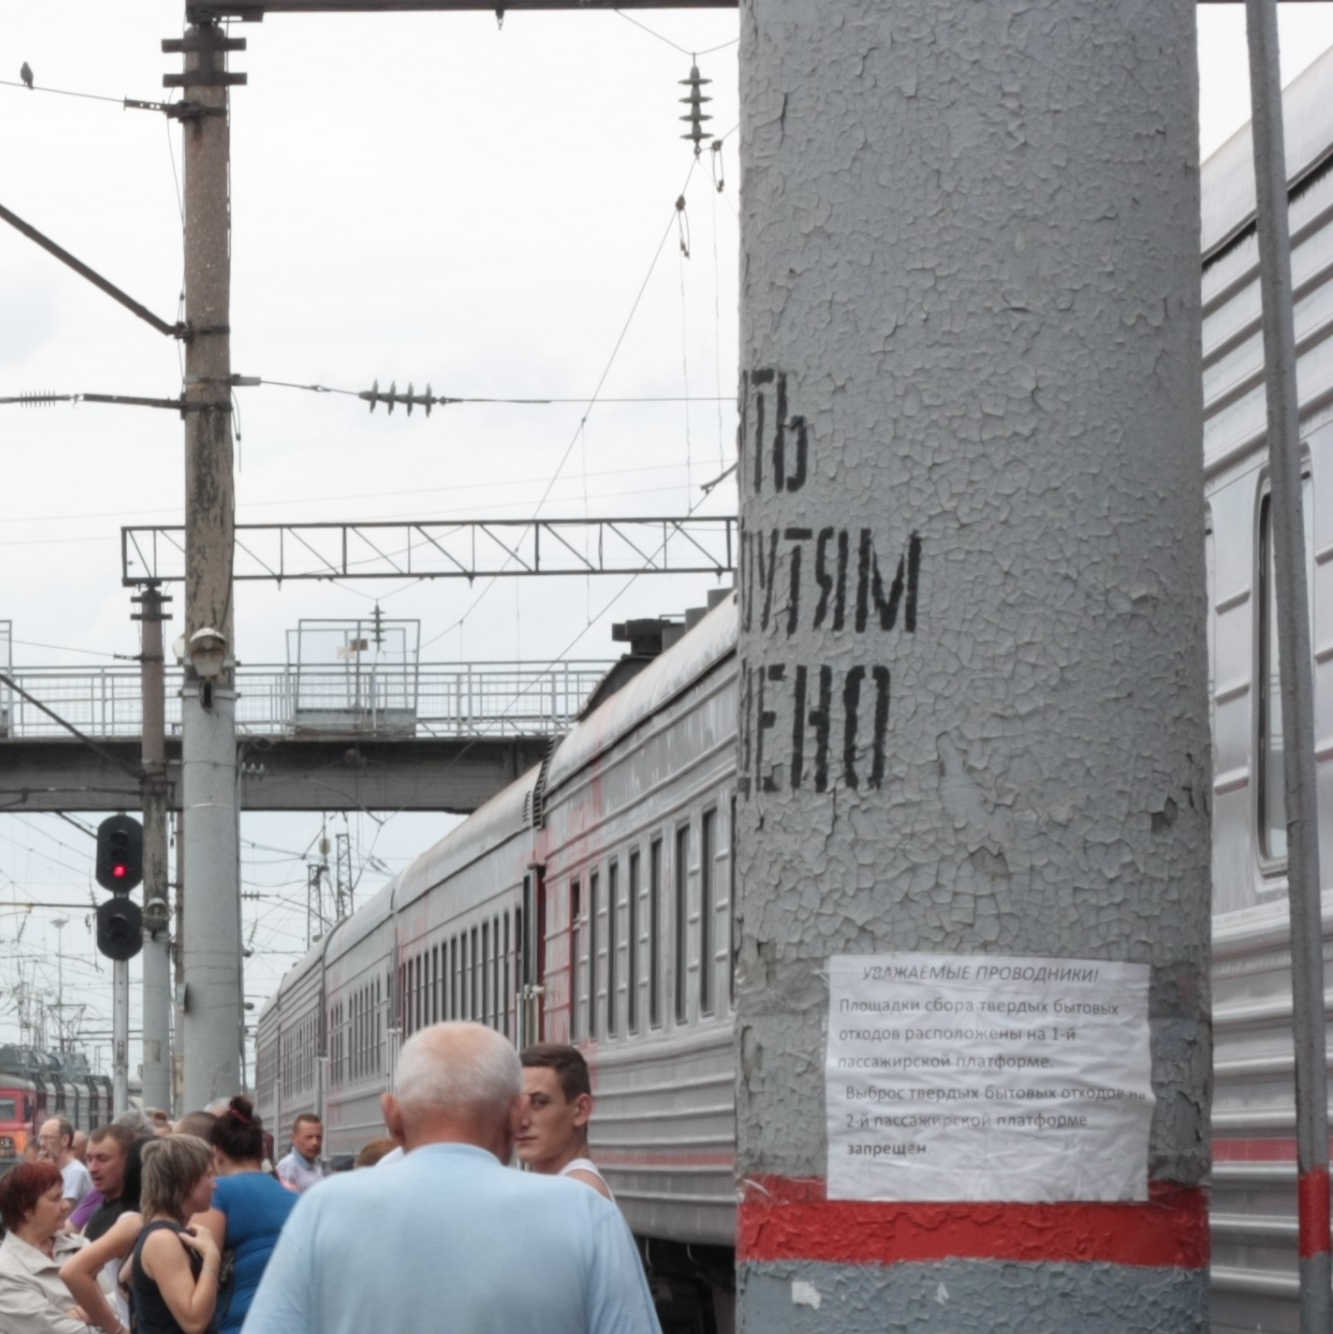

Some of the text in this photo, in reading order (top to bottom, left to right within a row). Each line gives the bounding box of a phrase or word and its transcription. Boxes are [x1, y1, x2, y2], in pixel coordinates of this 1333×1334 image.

[862, 965, 1099, 983] УВАЖАЕМЫЕ ПРОВОДНИКИ!
[839, 997, 1119, 1016] Площадки сбора твердых бытовых
[839, 1026, 1076, 1043] отходов расположены на 1-й
[838, 1053, 951, 1071] пассажирской
[846, 1085, 905, 1101] Выброс
[909, 1087, 979, 1102] твердых
[984, 1084, 1056, 1100] бытовых
[846, 1112, 1088, 1129] 2-й пассажирской платформе
